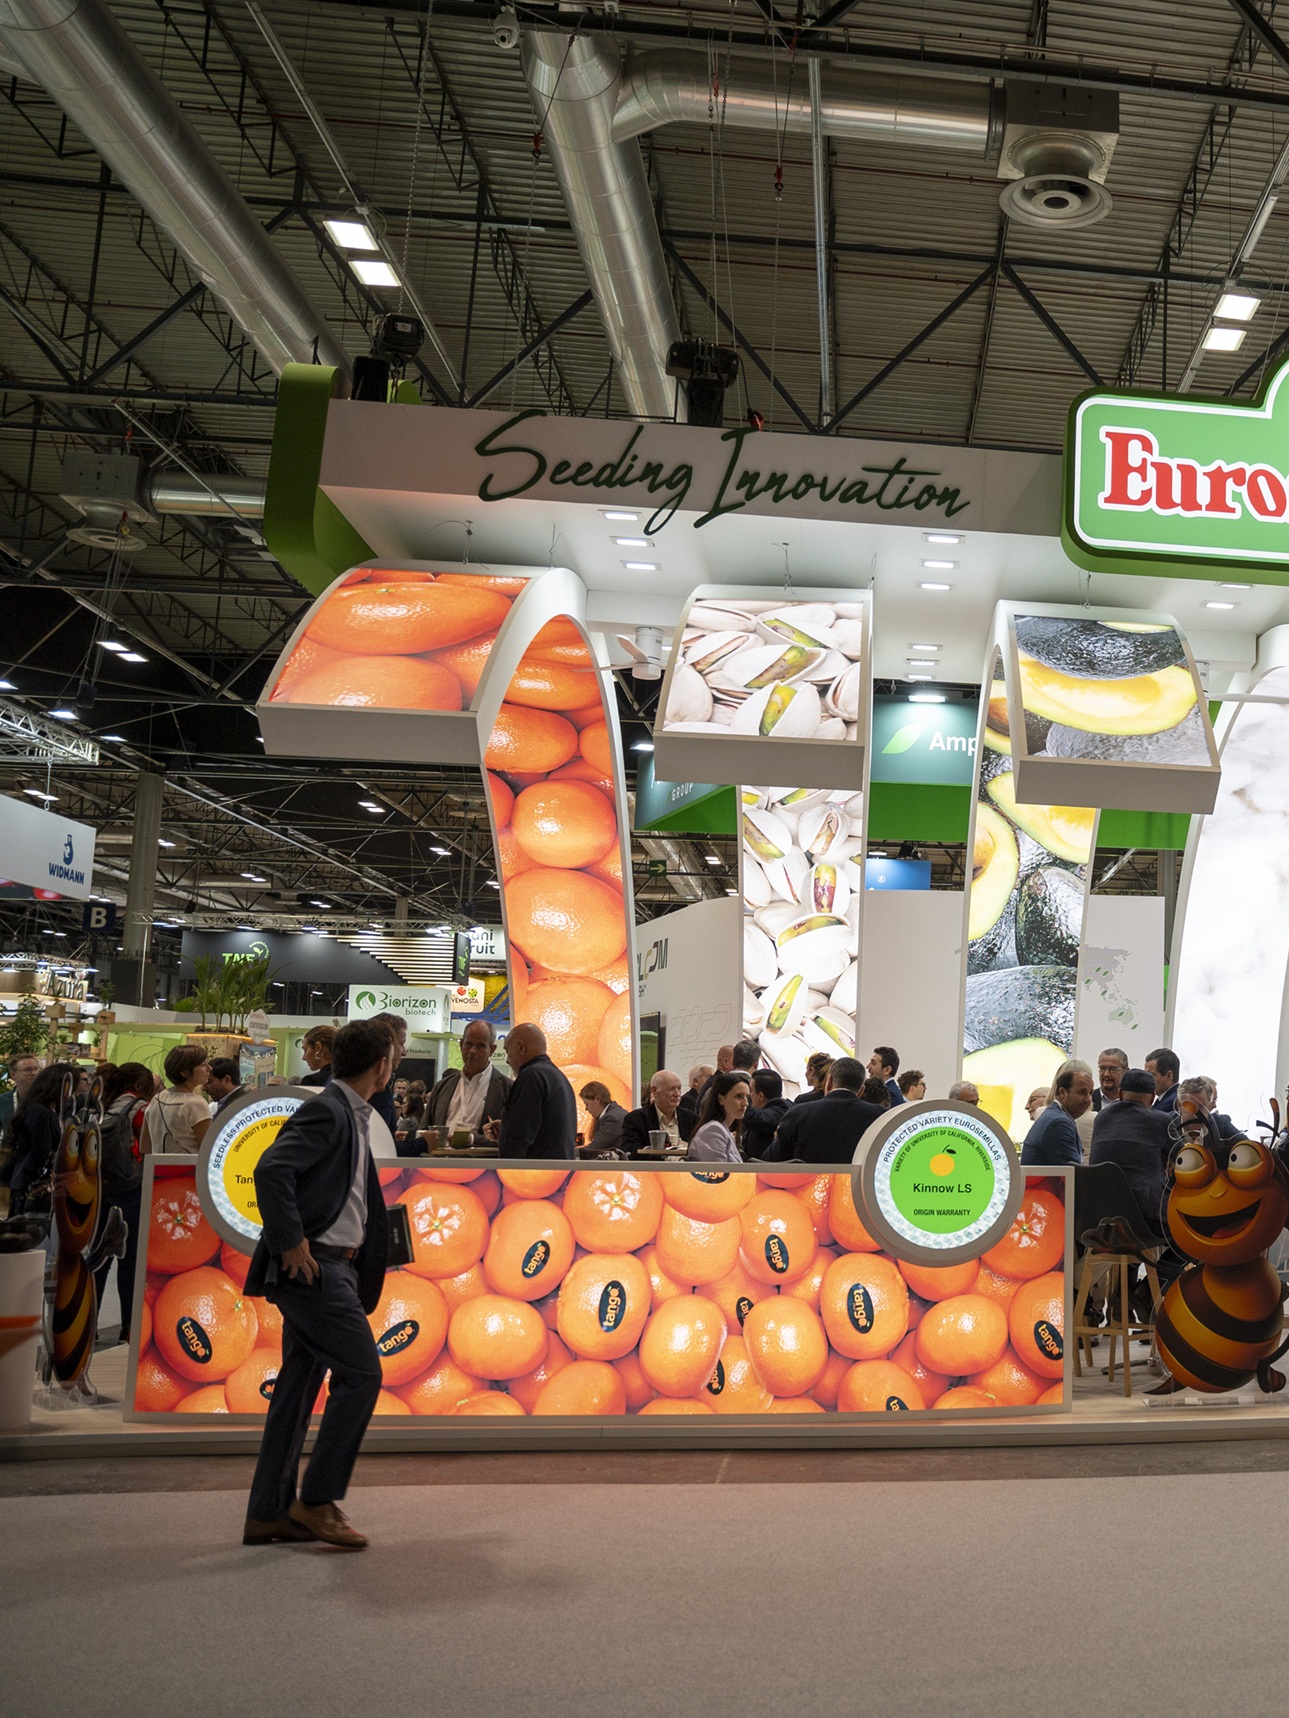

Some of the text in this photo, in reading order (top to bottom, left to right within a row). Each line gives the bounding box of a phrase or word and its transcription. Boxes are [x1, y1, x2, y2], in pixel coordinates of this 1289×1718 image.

[475, 409, 971, 535] Seeding Innovation
[928, 731, 978, 757] Amp
[49, 863, 85, 885] WIDMANN
[90, 907, 107, 928] B
[379, 991, 437, 1010] Biorizon
[405, 1008, 437, 1016] biotech
[213, 1128, 237, 1169] SEEDLESS
[236, 1106, 283, 1129] PROTECTED
[233, 1126, 261, 1153] UNIVERSITY
[260, 1122, 269, 1130] OF
[883, 1116, 1002, 1163] PROTECTED VARIETY EUROSEMILLAS
[894, 1150, 908, 1173] VARIETY
[911, 1130, 939, 1148] UNIVERSITY
[975, 1145, 991, 1172] RIVERSIDE
[913, 1183, 972, 1193] Kinnow LS
[913, 1208, 971, 1216] ORIGIN WARRANTY
[524, 1244, 547, 1275] tango
[768, 1238, 783, 1269] tango
[603, 1287, 621, 1328] tango
[853, 1288, 868, 1328] tango
[182, 1320, 206, 1357] tango
[379, 1326, 415, 1353] tango
[1038, 1323, 1060, 1356] tango
